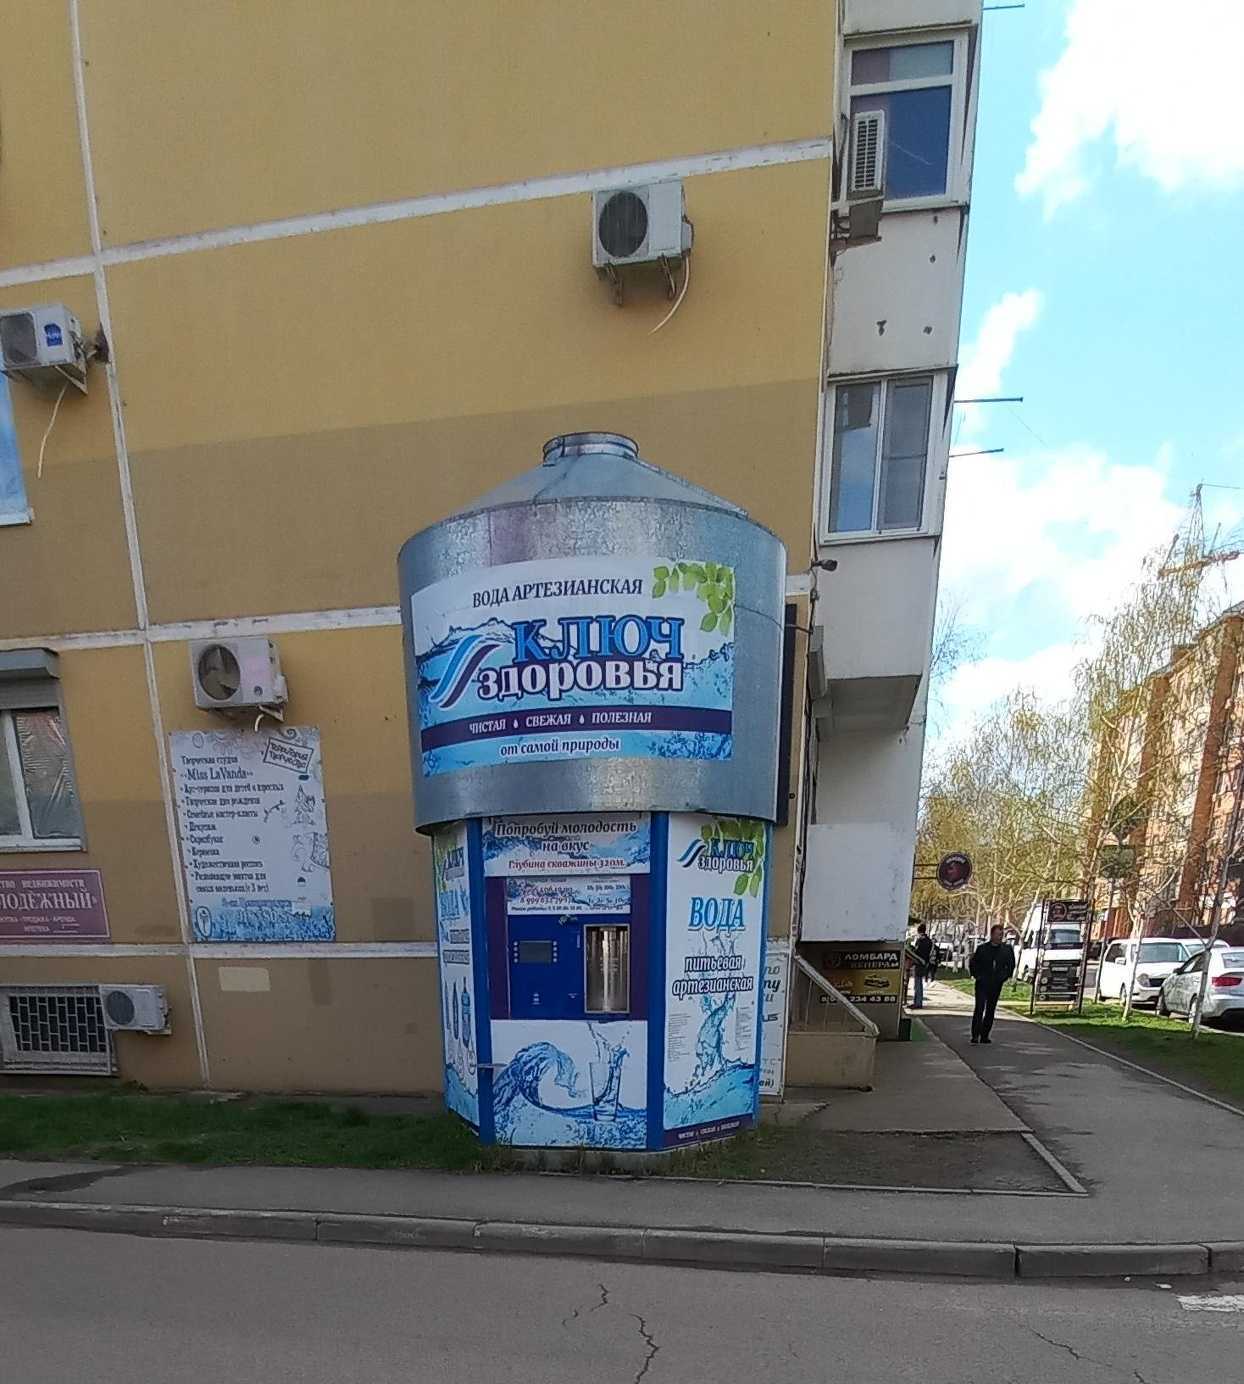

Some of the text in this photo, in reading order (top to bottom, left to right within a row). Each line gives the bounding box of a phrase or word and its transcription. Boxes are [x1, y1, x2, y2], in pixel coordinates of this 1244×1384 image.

[473, 578, 643, 608] ВОДА АРТЕЗИАНСКАЯ
[512, 615, 684, 663] КЛЮЧ
[476, 660, 683, 700] здоровья
[469, 711, 652, 733] ЧИСТАЯ СВЕЖАЯ ПОЛЕЗНАЯ
[500, 738, 620, 756] от самой природы
[496, 821, 638, 838] Попробуй молодость
[542, 841, 591, 854] на вкус
[710, 839, 754, 858] КЛЮЧ
[508, 860, 545, 871] Глубина
[547, 859, 597, 868] скважины
[698, 856, 754, 874] здоровья
[689, 897, 745, 930] ВОДА
[685, 955, 743, 973] питьевая
[672, 976, 754, 997] артезианская
